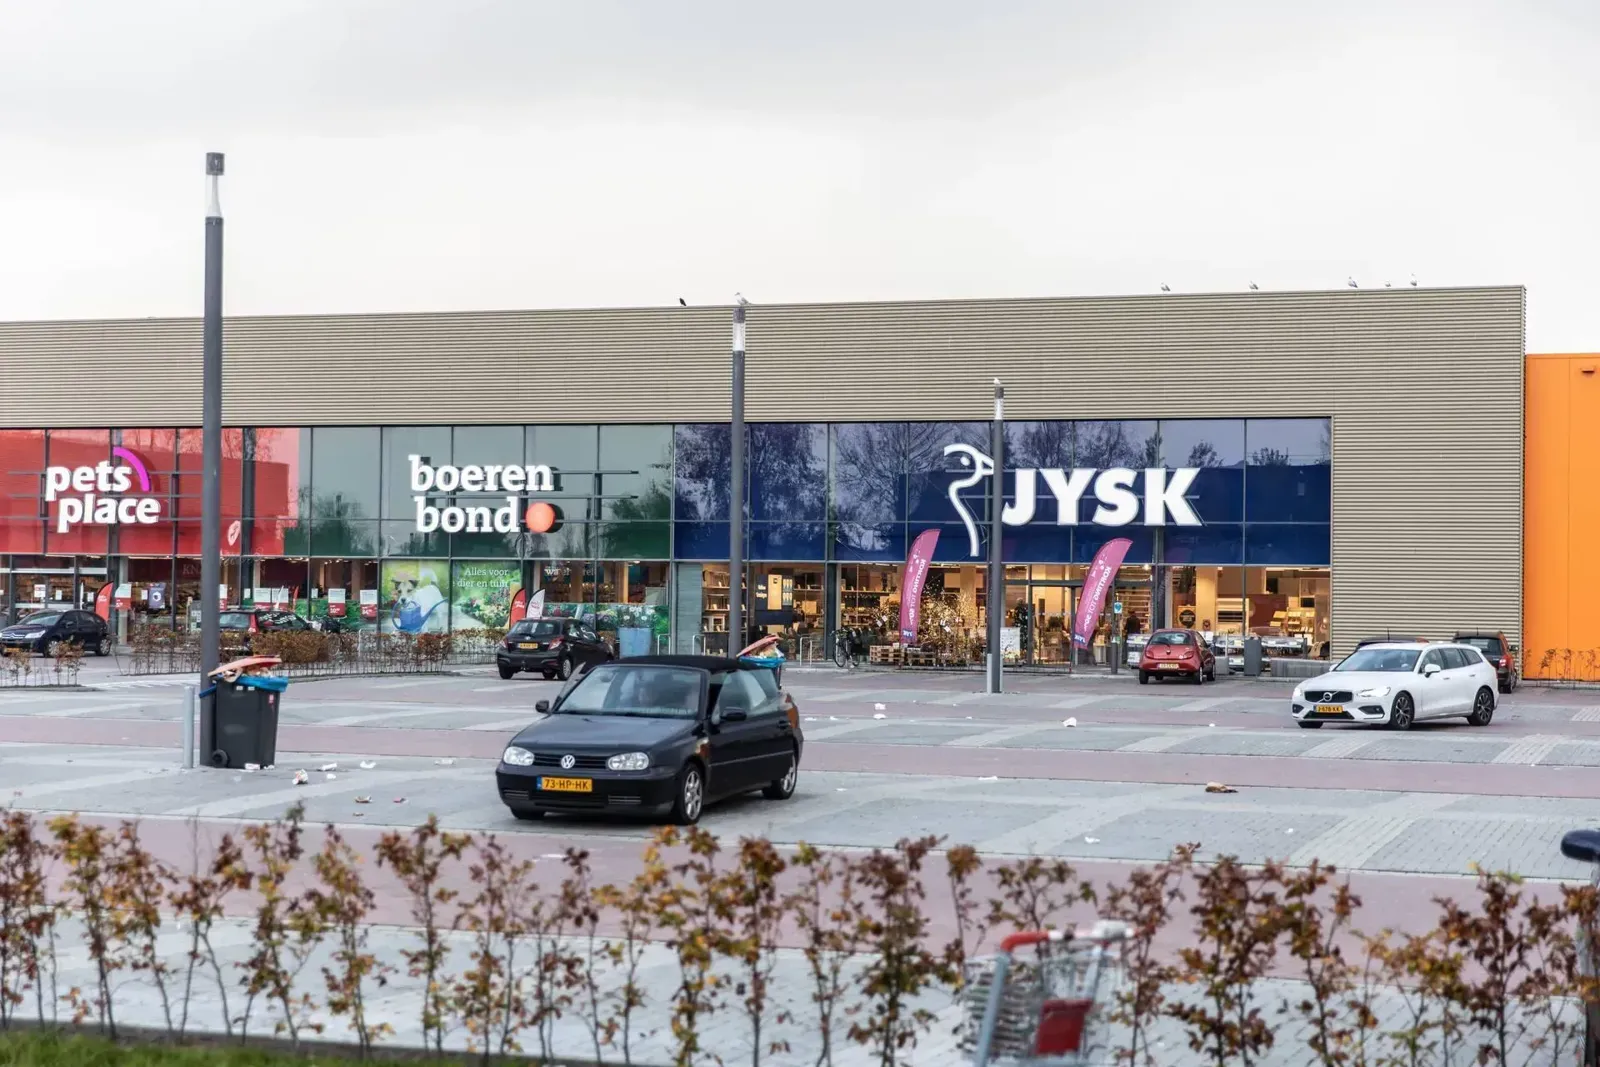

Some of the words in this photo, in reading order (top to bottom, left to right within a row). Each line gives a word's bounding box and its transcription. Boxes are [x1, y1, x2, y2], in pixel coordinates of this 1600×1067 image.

[45, 460, 133, 501] pets
[407, 454, 554, 491] boeren
[57, 494, 161, 533] place
[414, 496, 522, 533] bond
[1002, 467, 1204, 527] JYSK
[457, 579, 475, 587] dier
[464, 566, 487, 576] Alles
[544, 779, 588, 789] 73-HP-HK
